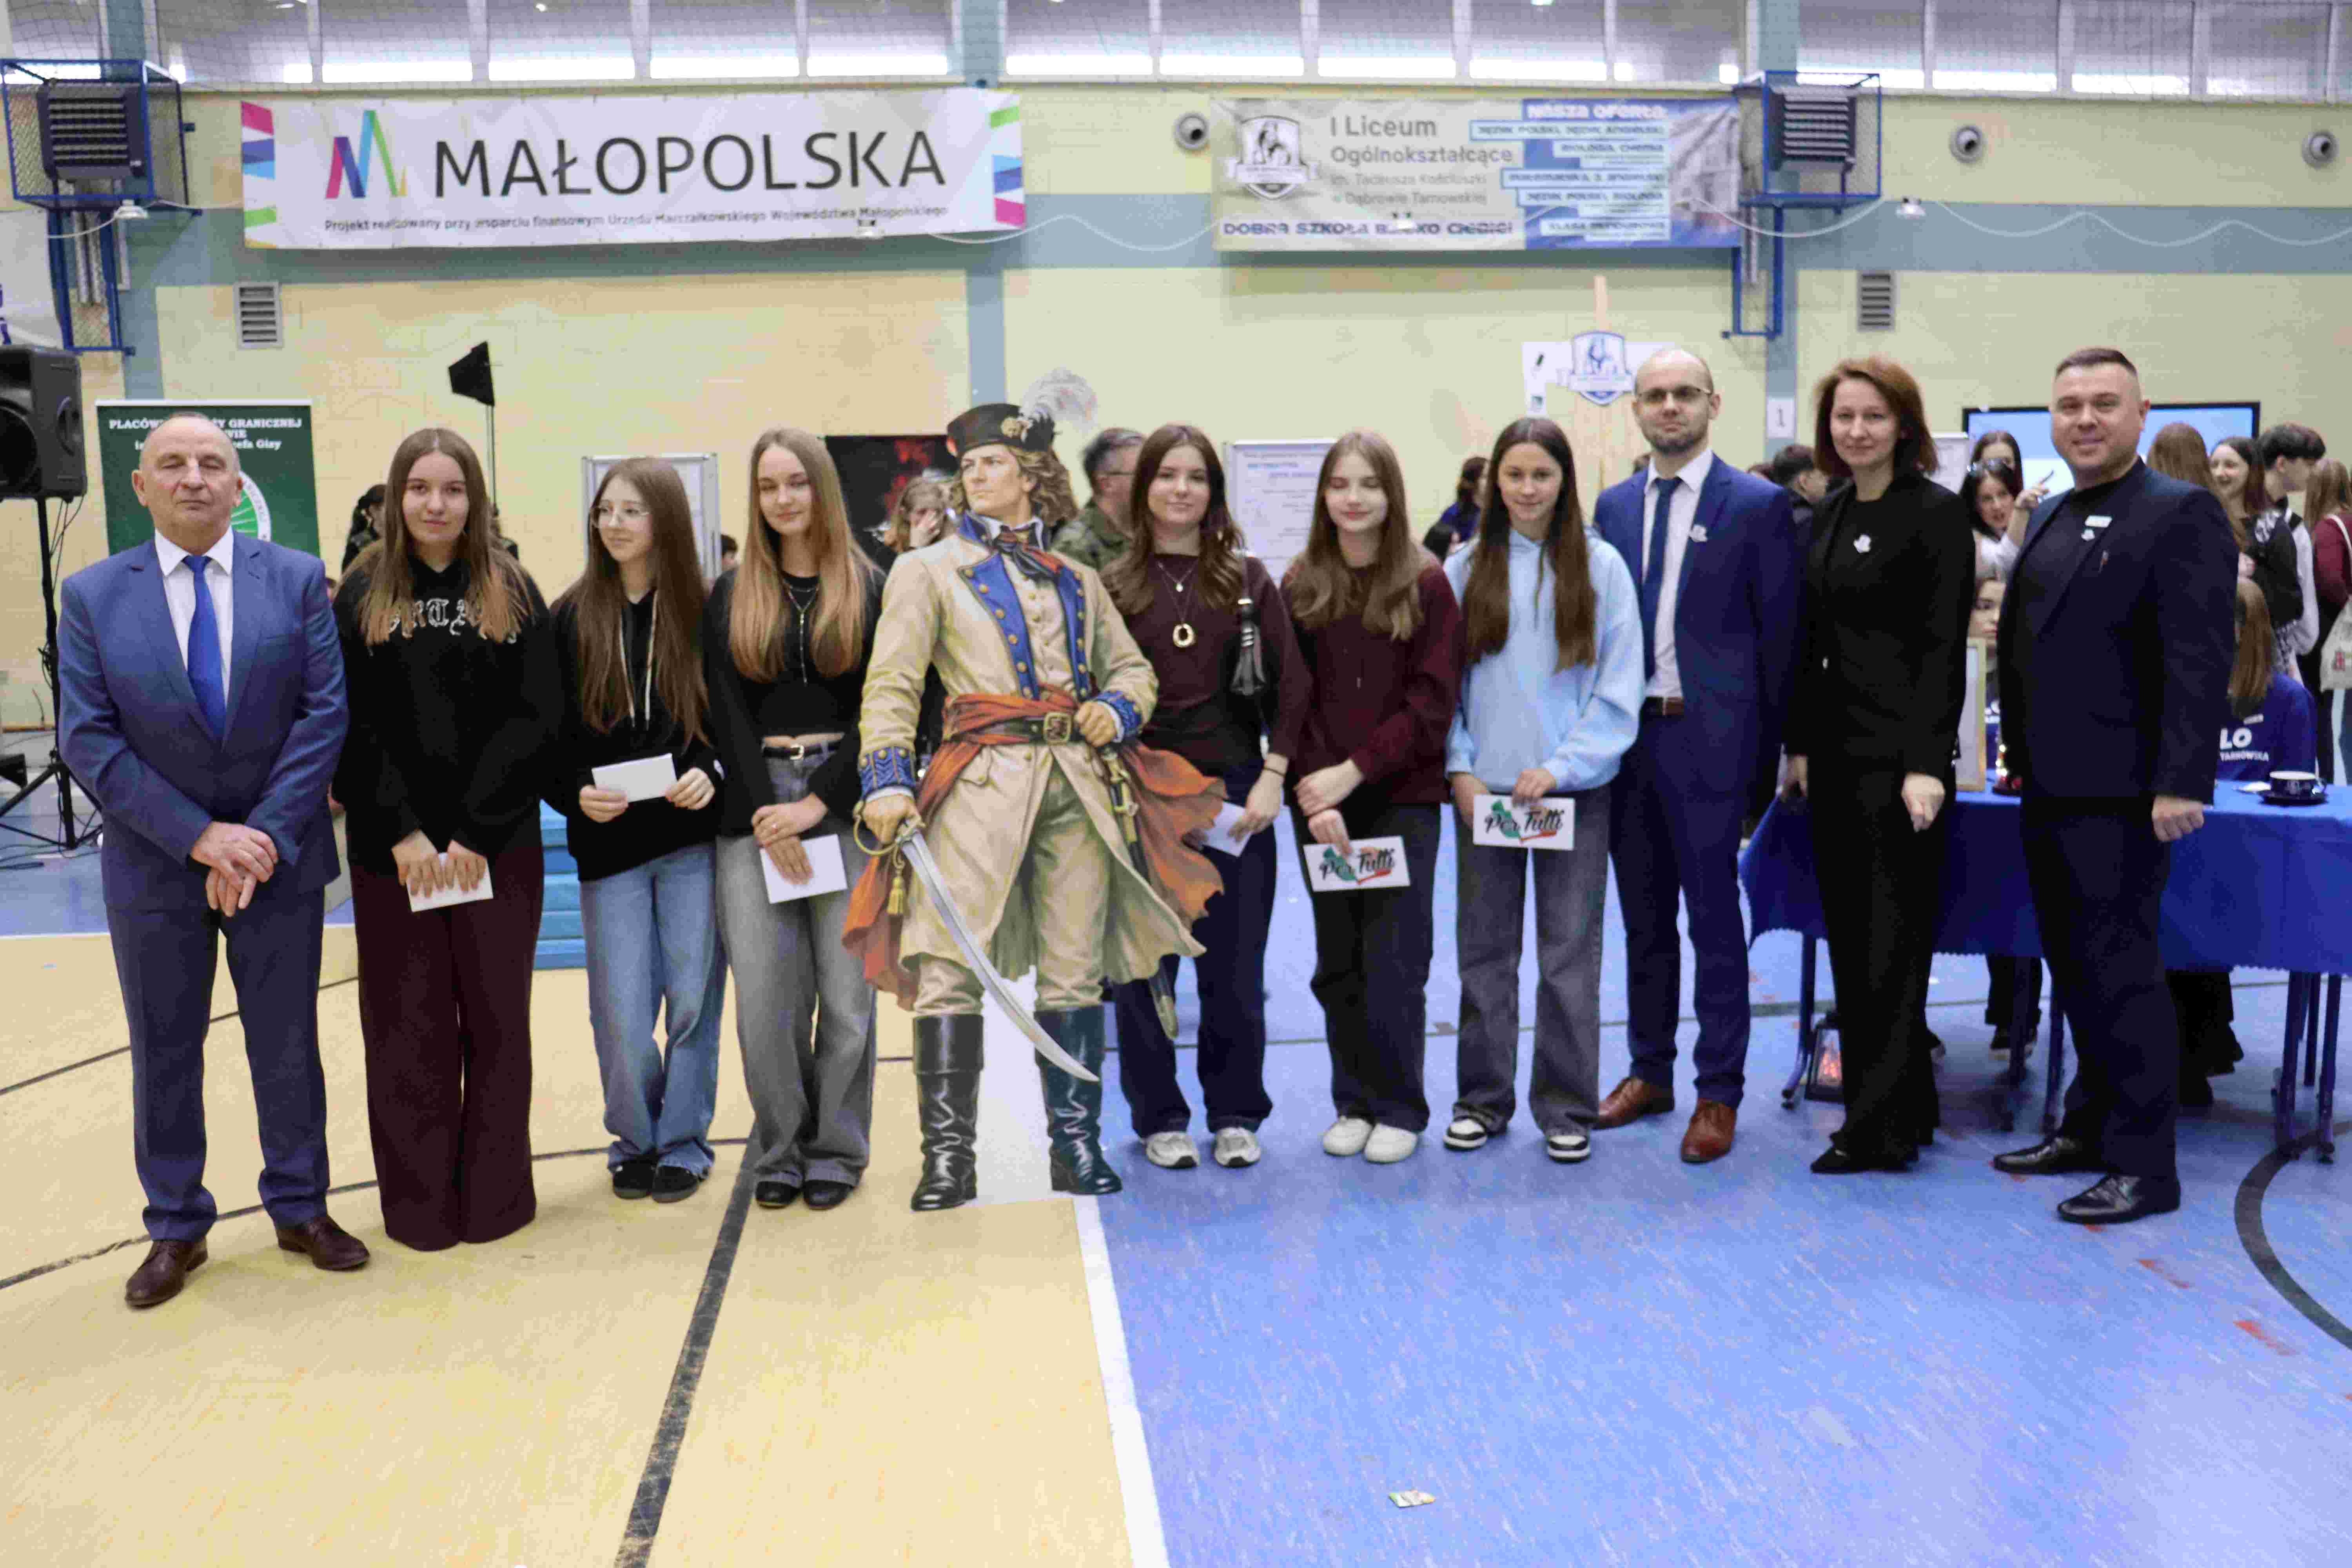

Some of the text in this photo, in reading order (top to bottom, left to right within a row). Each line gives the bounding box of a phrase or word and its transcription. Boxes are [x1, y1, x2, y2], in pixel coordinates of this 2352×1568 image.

[1331, 116, 1437, 137] I Liceum
[435, 131, 946, 198] MAŁOPOLSKA
[1331, 145, 1512, 168] Ogólnokształcące
[325, 219, 369, 232] Projekt
[372, 218, 440, 231] realizowany
[445, 218, 471, 231] przy
[475, 217, 530, 230] wsparciu
[533, 214, 604, 228] finansowym
[1224, 223, 1289, 235] DOBRA
[1296, 222, 1368, 235] SZKOŁA
[228, 418, 301, 428] GRANICZNEJ
[2220, 728, 2252, 750] LO
[1524, 808, 1564, 833] Tutti
[1357, 848, 1396, 874] Tutti
